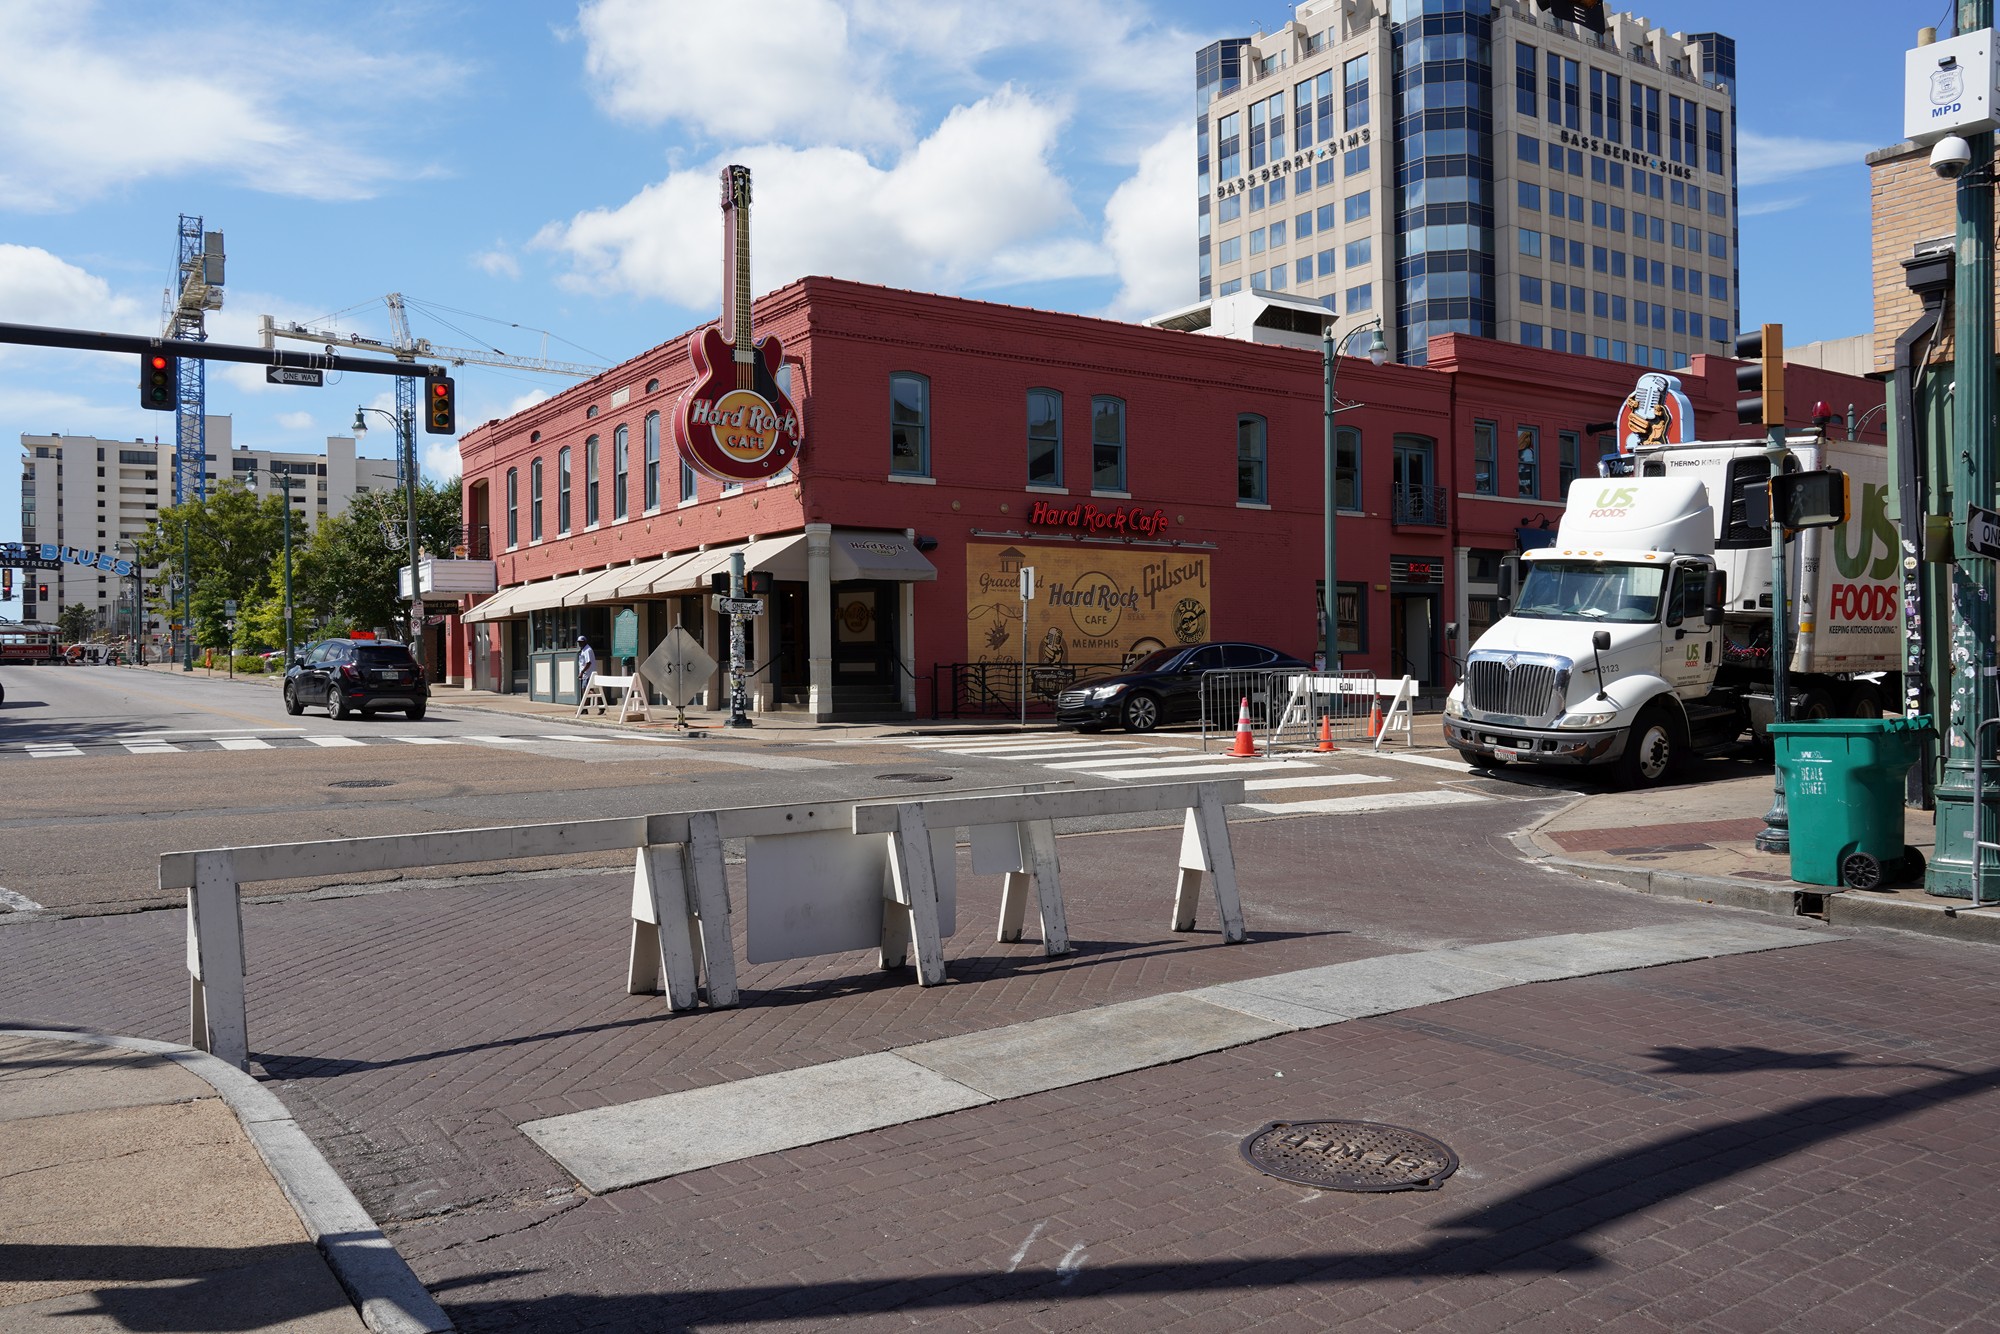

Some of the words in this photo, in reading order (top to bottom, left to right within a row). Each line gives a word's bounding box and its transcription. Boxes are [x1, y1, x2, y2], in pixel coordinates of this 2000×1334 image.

[1932, 103, 1962, 117] MPD
[1561, 130, 1599, 152] BASS
[1603, 143, 1649, 167] BERRY
[1660, 161, 1692, 180] SIMS
[1217, 173, 1256, 198] BASS
[1261, 150, 1314, 181] BERRY
[1328, 128, 1371, 156] SIMS
[301, 374, 317, 382] WAY
[692, 399, 745, 428] Hard
[748, 405, 797, 438] Rock
[728, 435, 765, 449] CAFE
[1032, 501, 1082, 526] Hard
[1083, 504, 1127, 533] Rock
[1129, 508, 1169, 536] Cafe
[1589, 509, 1628, 518] FOODS
[3, 550, 28, 559] THE
[850, 542, 878, 550] Hard
[879, 543, 908, 553] Rock
[20, 560, 54, 568] STREET
[40, 543, 133, 576] BLUES
[1409, 563, 1431, 573] ROCK
[979, 572, 1044, 594] Graceld
[1143, 559, 1207, 610] Gibson
[1049, 583, 1096, 608] Hard
[1097, 584, 1141, 613] Rock
[1830, 584, 1898, 622] FOODS
[1179, 600, 1202, 614] SUN
[1084, 615, 1107, 625] CAFE
[1829, 625, 1849, 634] KEEPING
[1850, 625, 1873, 634] KITCHENS
[1072, 639, 1119, 649] MEMPHIS
[1800, 767, 1823, 781] BEALE
[1800, 782, 1827, 795] STREET
